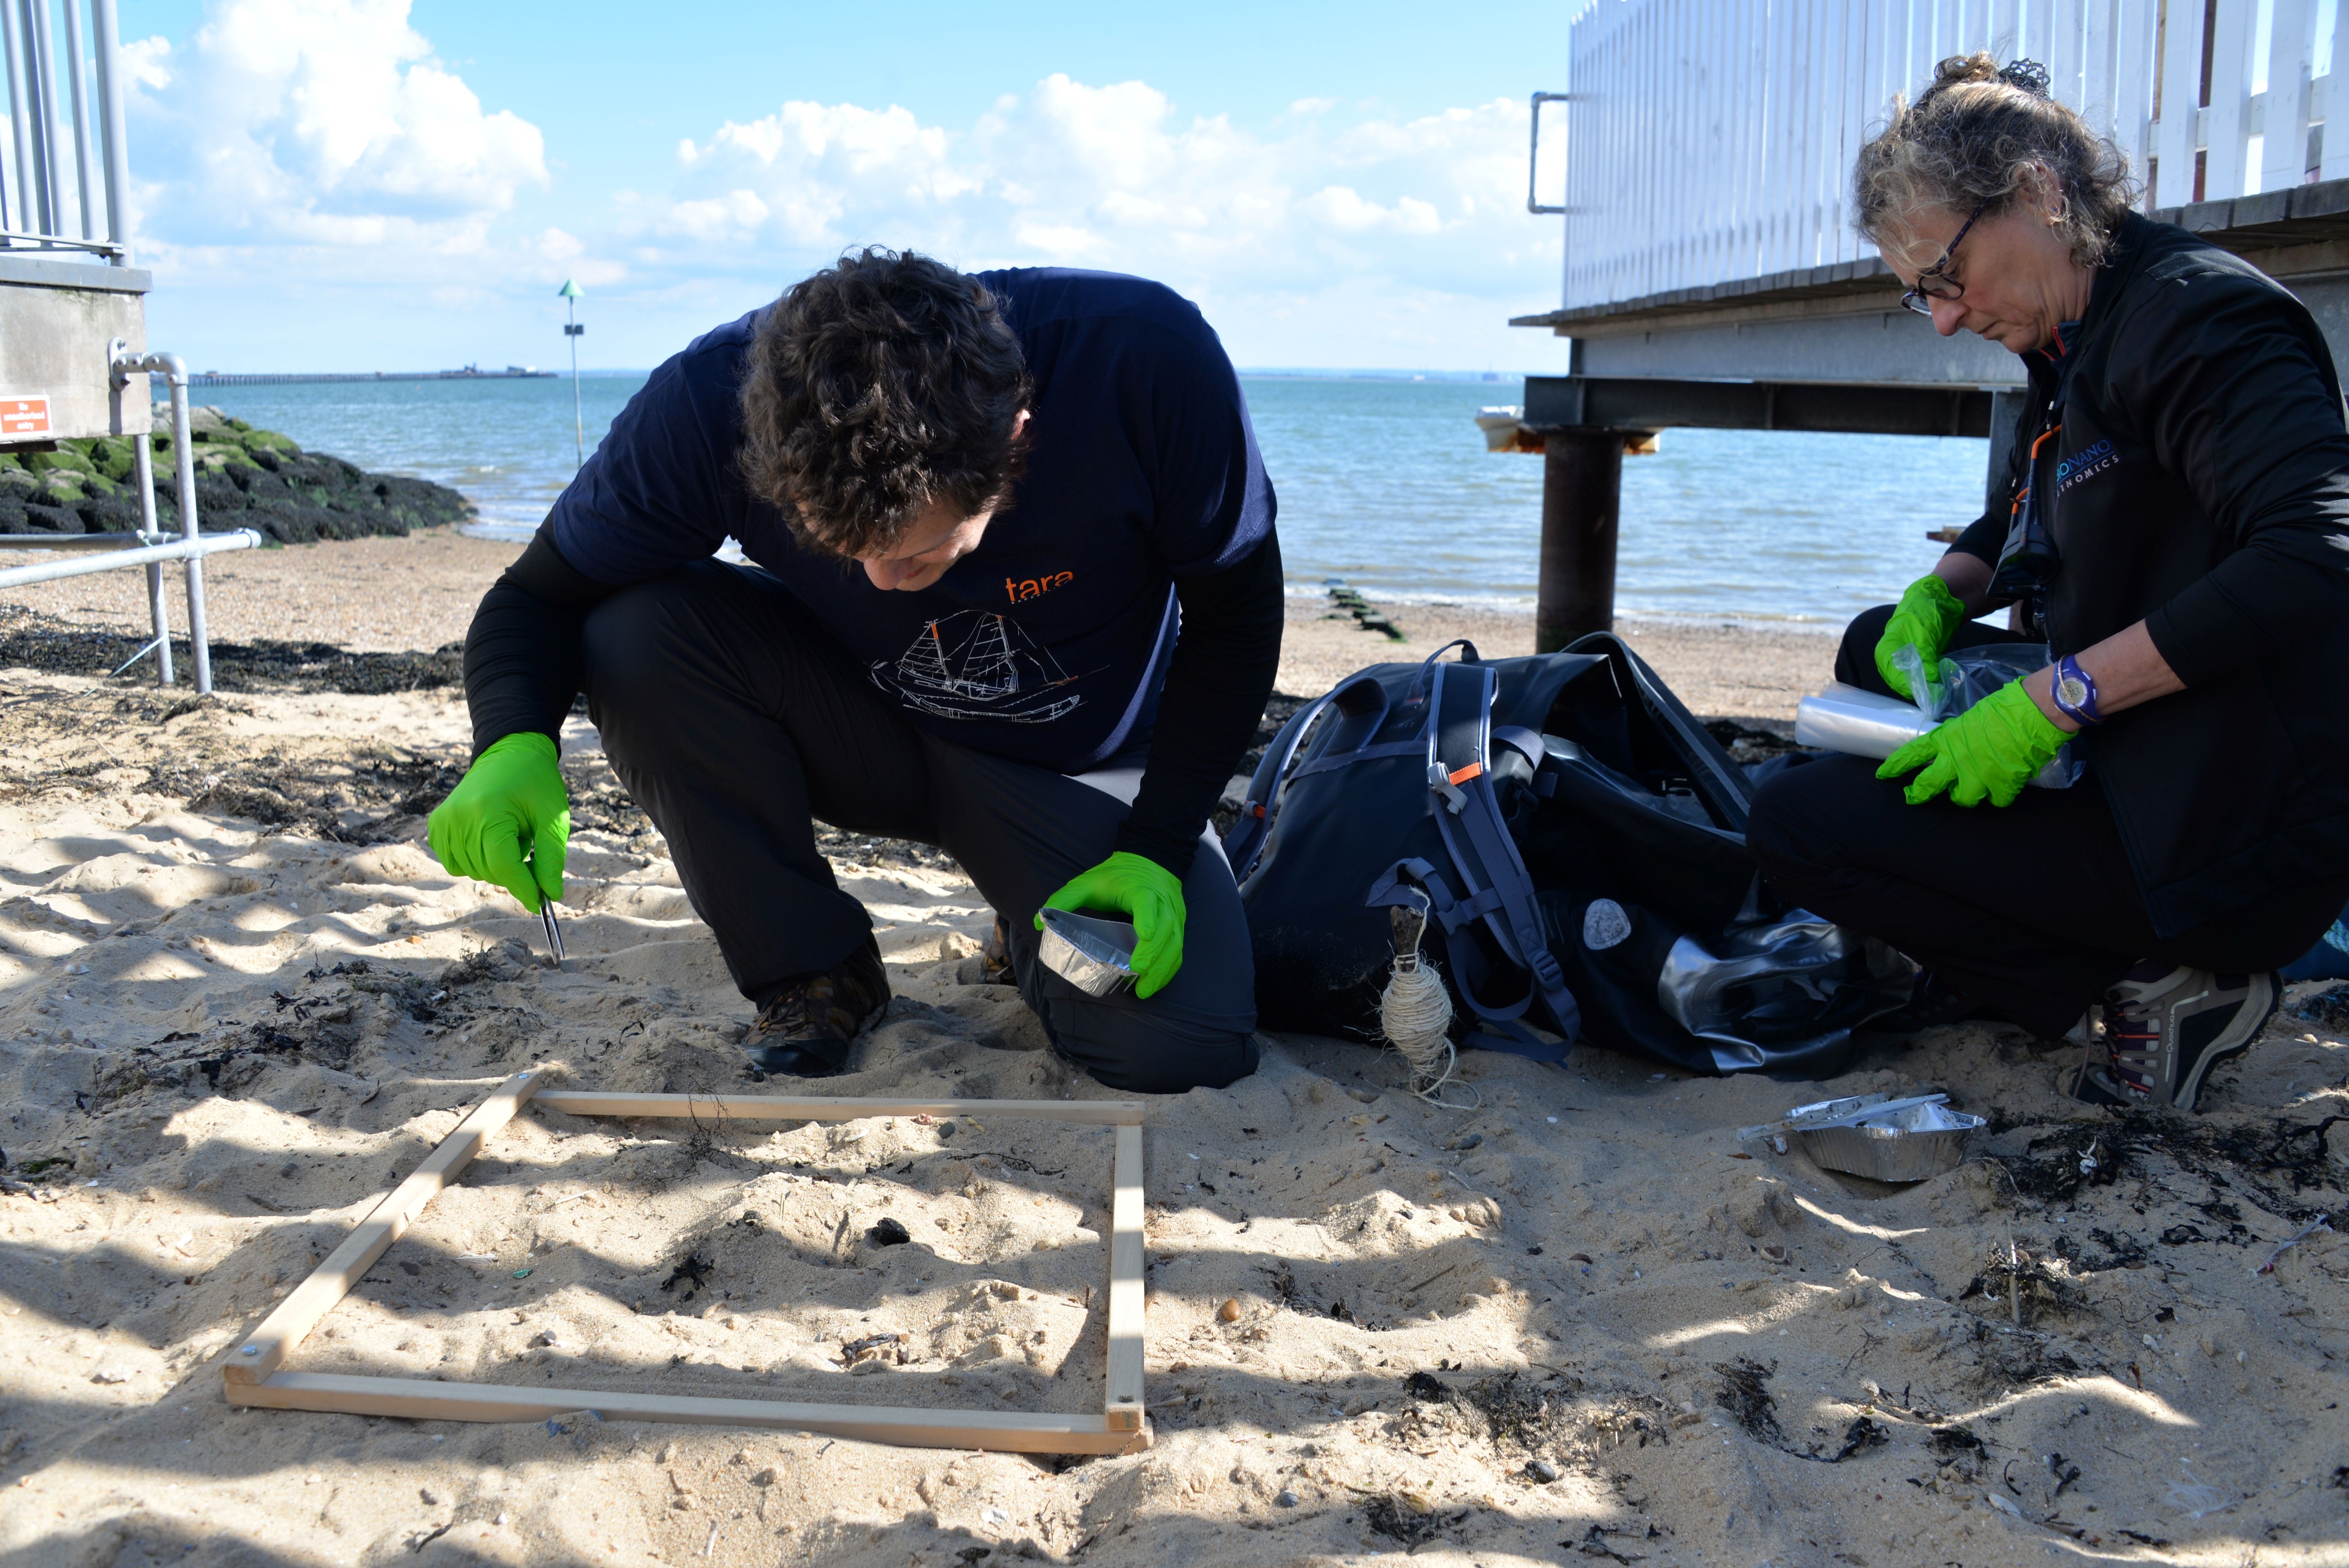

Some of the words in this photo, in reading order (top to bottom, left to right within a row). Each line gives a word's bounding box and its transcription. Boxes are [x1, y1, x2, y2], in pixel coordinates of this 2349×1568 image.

[4, 411, 45, 421] unauthorised
[18, 422, 34, 430] entry
[1005, 570, 1074, 602] tara
[2166, 1015, 2174, 1053] Quechua
